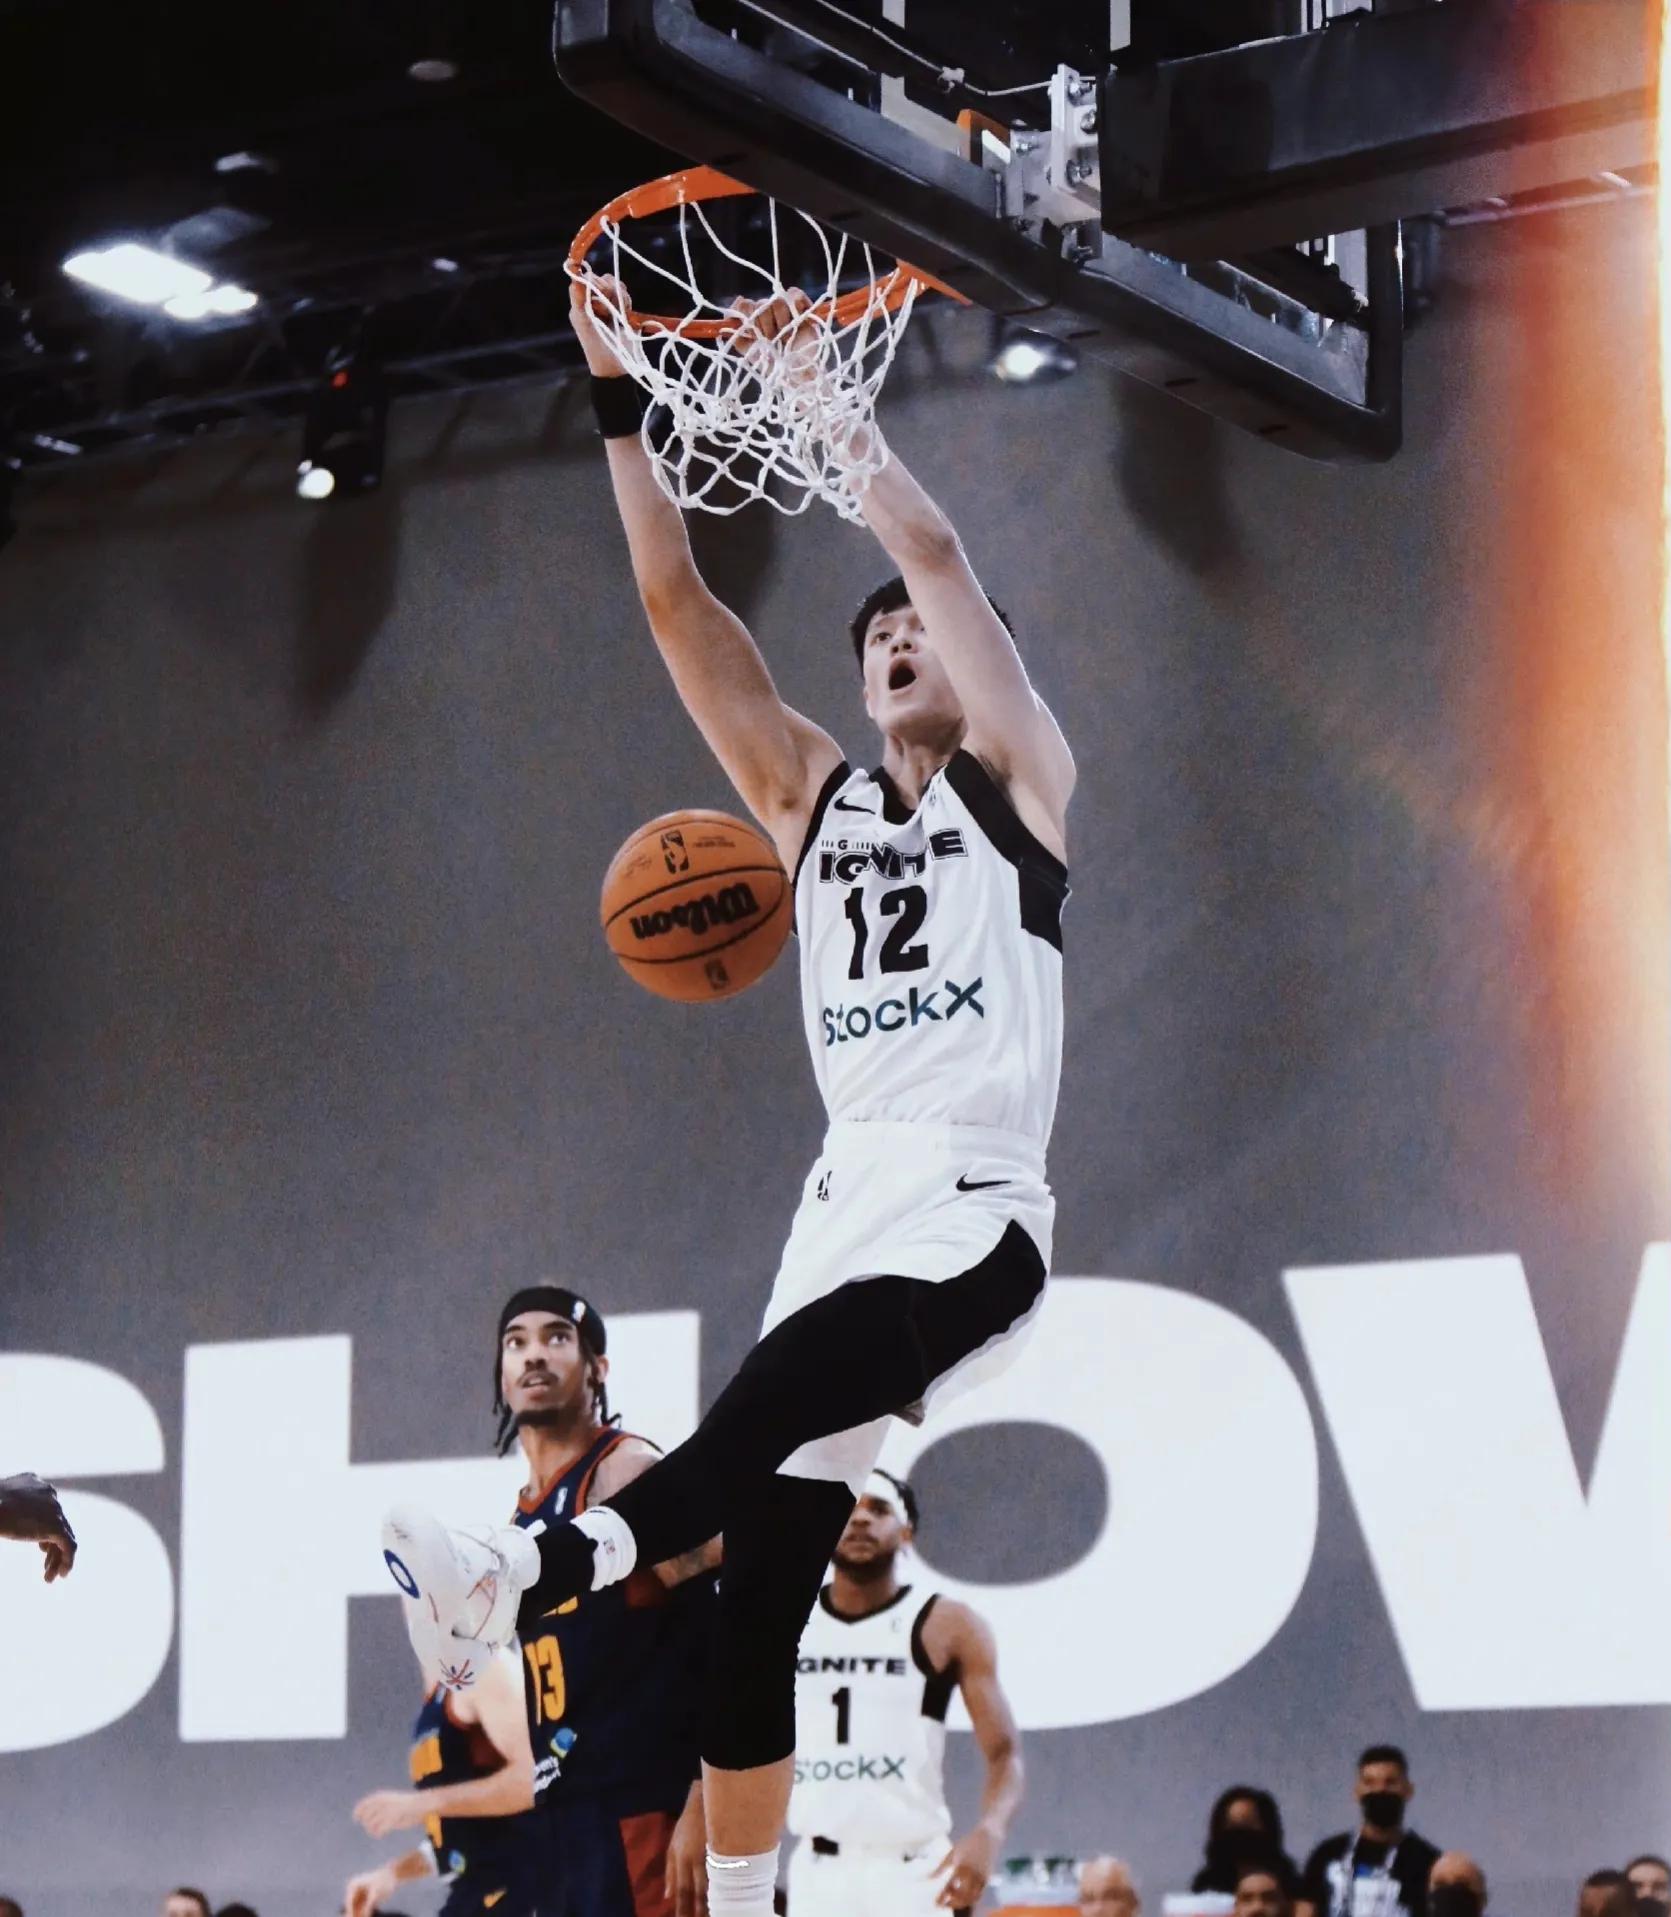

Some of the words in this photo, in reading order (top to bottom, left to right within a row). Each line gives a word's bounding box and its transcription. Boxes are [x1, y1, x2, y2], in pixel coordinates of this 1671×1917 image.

[629, 882, 761, 940] Wilson
[844, 885, 929, 980] 12
[524, 1634, 565, 1726] 13
[797, 1657, 906, 1676] GNITE
[831, 1687, 849, 1745] 1
